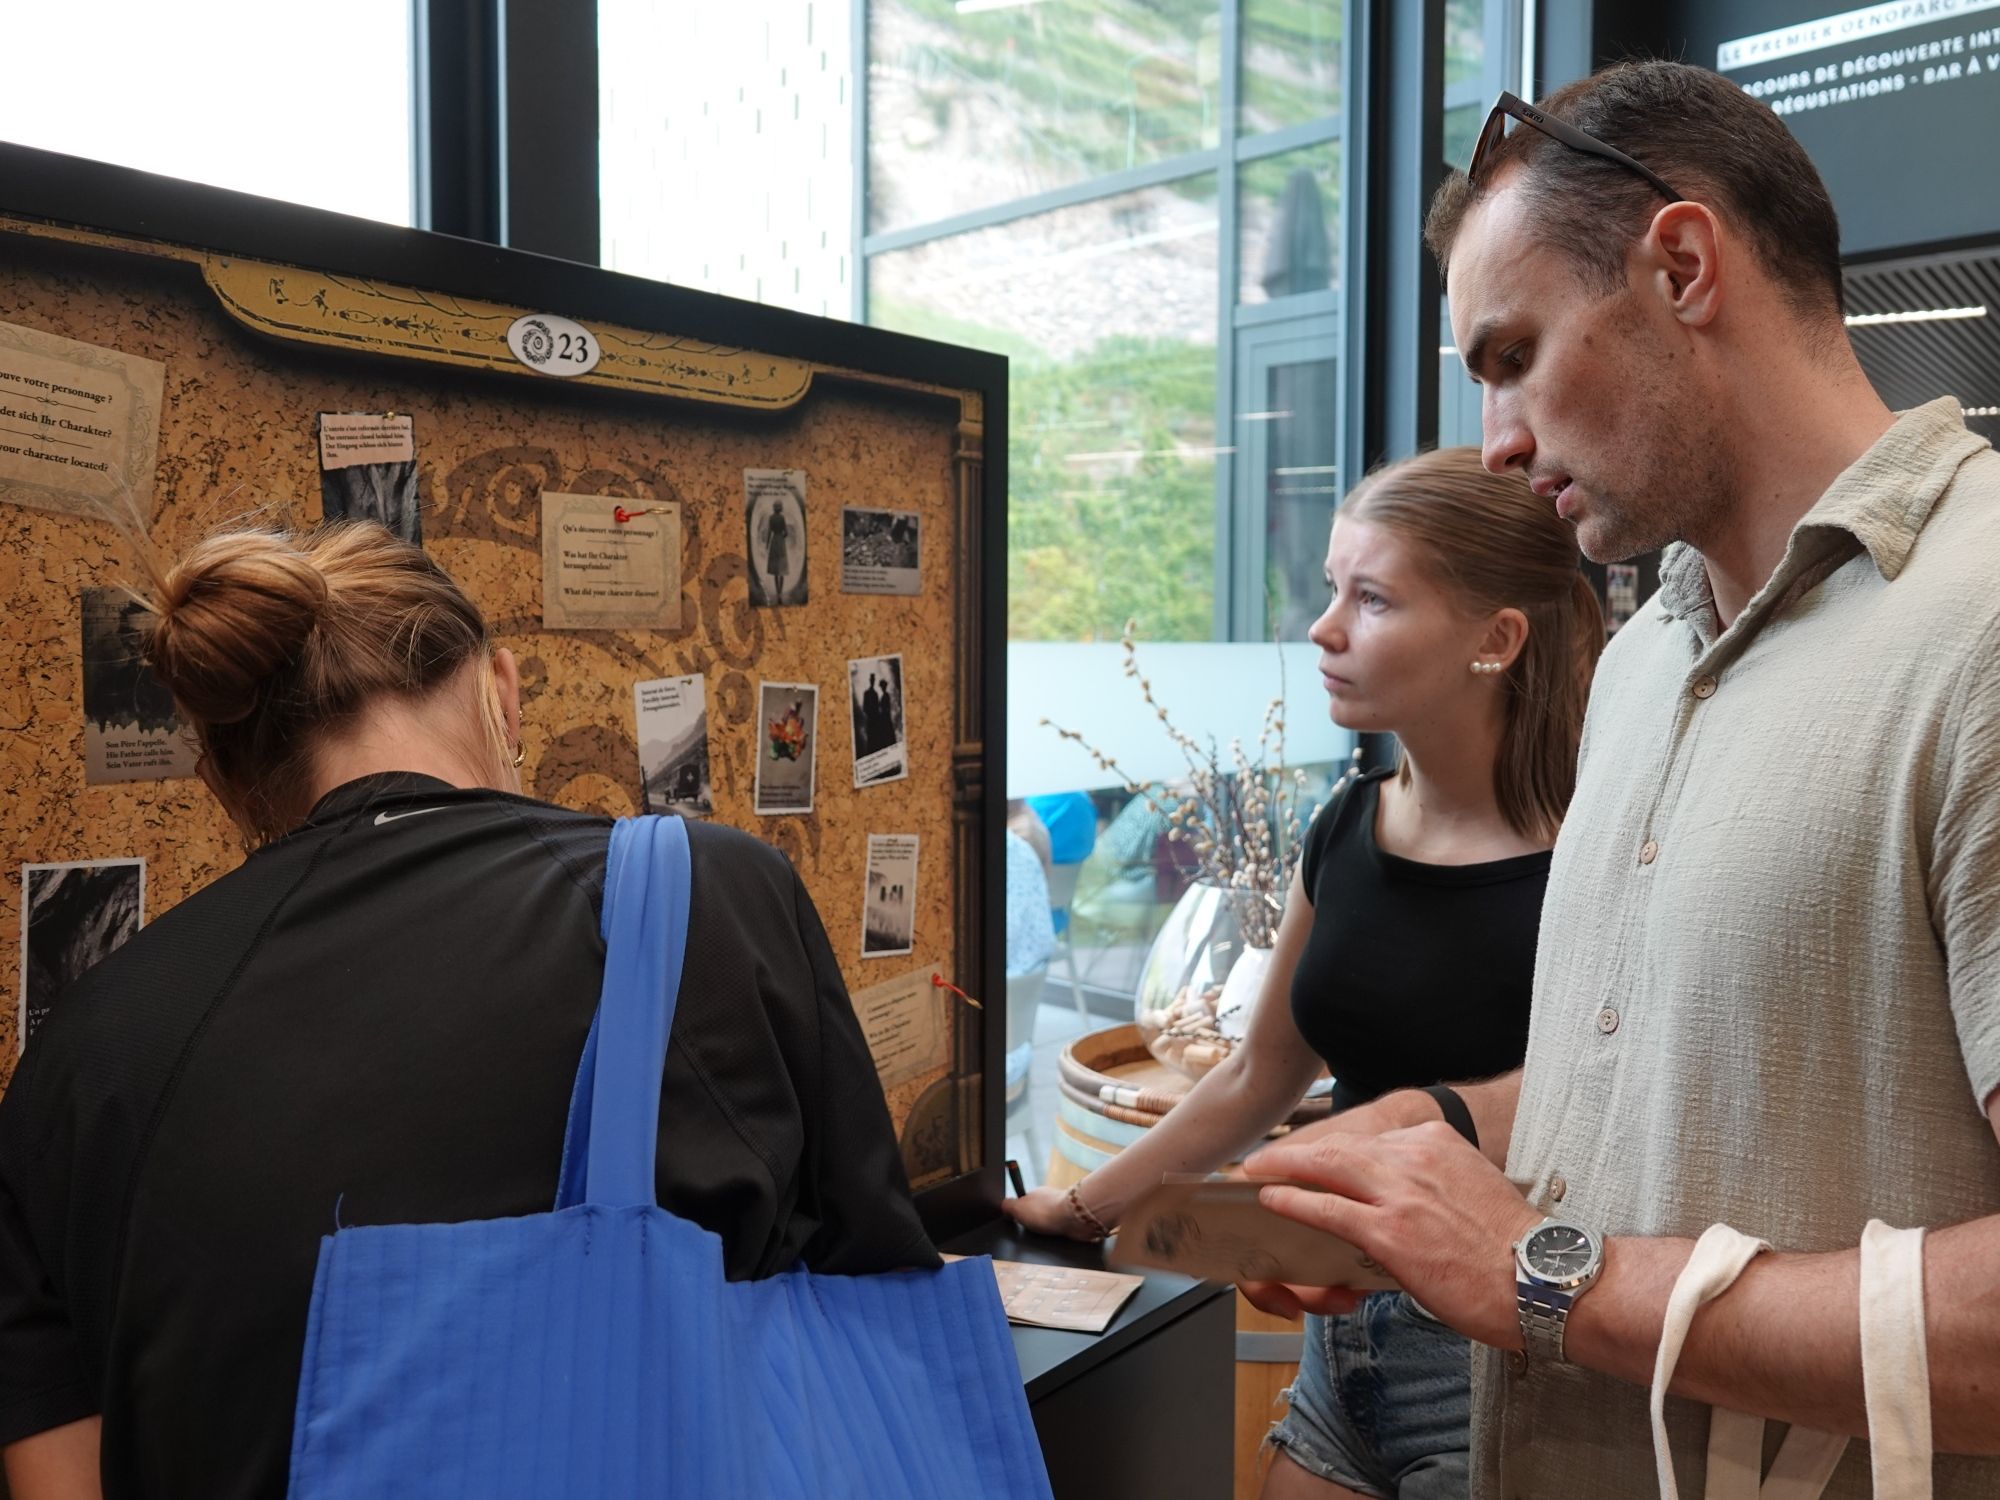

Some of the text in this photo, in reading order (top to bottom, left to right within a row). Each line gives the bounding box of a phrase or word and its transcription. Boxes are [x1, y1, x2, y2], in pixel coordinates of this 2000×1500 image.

[1814, 64, 1838, 84] DE
[1842, 35, 1964, 78] DÉCOUVERTE
[1771, 73, 1905, 116] DÉGUSTATIONS
[1922, 61, 1962, 85] BAR
[1966, 55, 1981, 75] À
[558, 333, 588, 363] 23
[24, 377, 50, 390] votre
[52, 384, 106, 404] personnage
[18, 411, 38, 423] sich
[41, 414, 57, 426] Ihr
[59, 419, 112, 438] Charakter?
[23, 448, 68, 464] character
[71, 456, 108, 472] located?
[563, 550, 576, 558] Was
[598, 552, 628, 560] Charakter
[563, 587, 580, 596] What
[582, 588, 592, 596] did
[593, 590, 606, 598] your
[120, 750, 142, 758] Father
[122, 760, 142, 768] Vater
